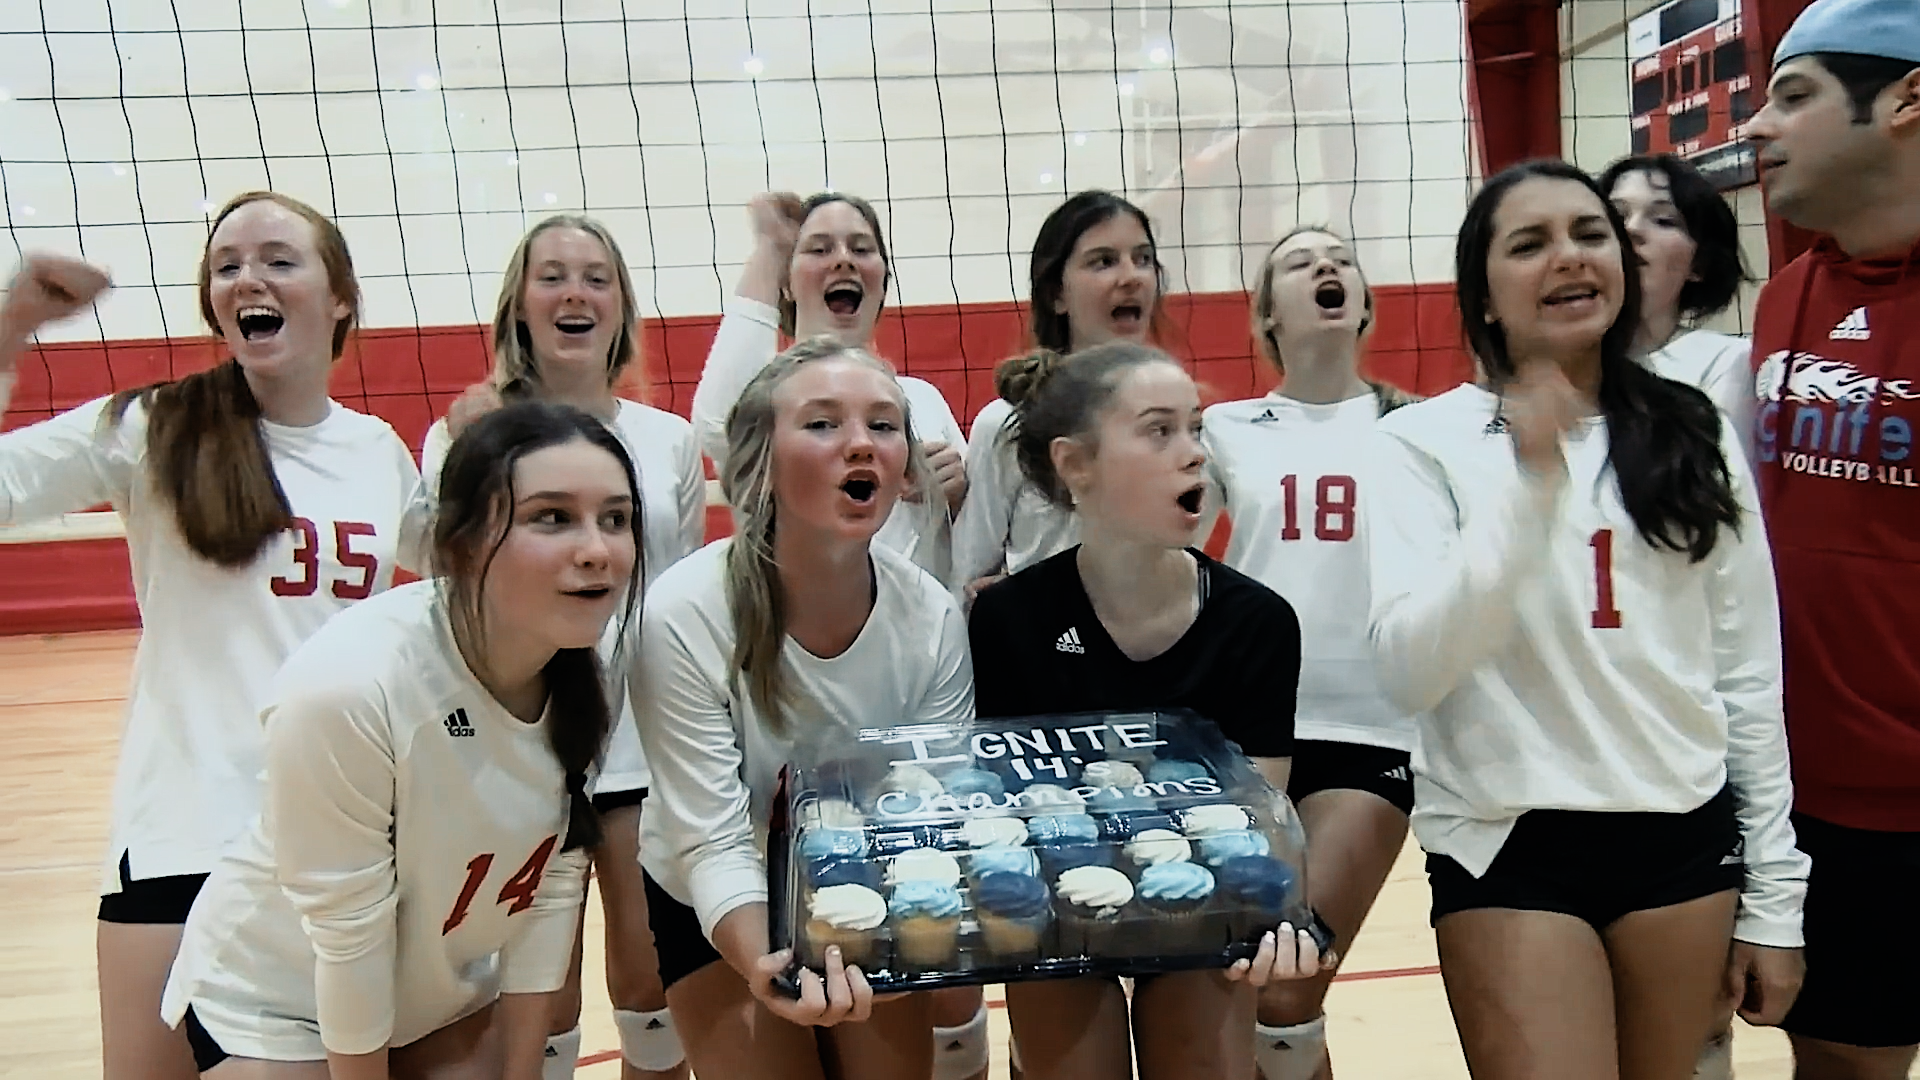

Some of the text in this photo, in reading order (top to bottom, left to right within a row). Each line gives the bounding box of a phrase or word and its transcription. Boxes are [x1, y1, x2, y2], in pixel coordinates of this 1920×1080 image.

[1781, 451, 1920, 488] VOLLEYBALL
[1280, 474, 1357, 541] 18
[270, 516, 378, 600] 35
[1587, 528, 1623, 629] 1
[881, 722, 1169, 767] IGNITE
[441, 833, 559, 937] 14
